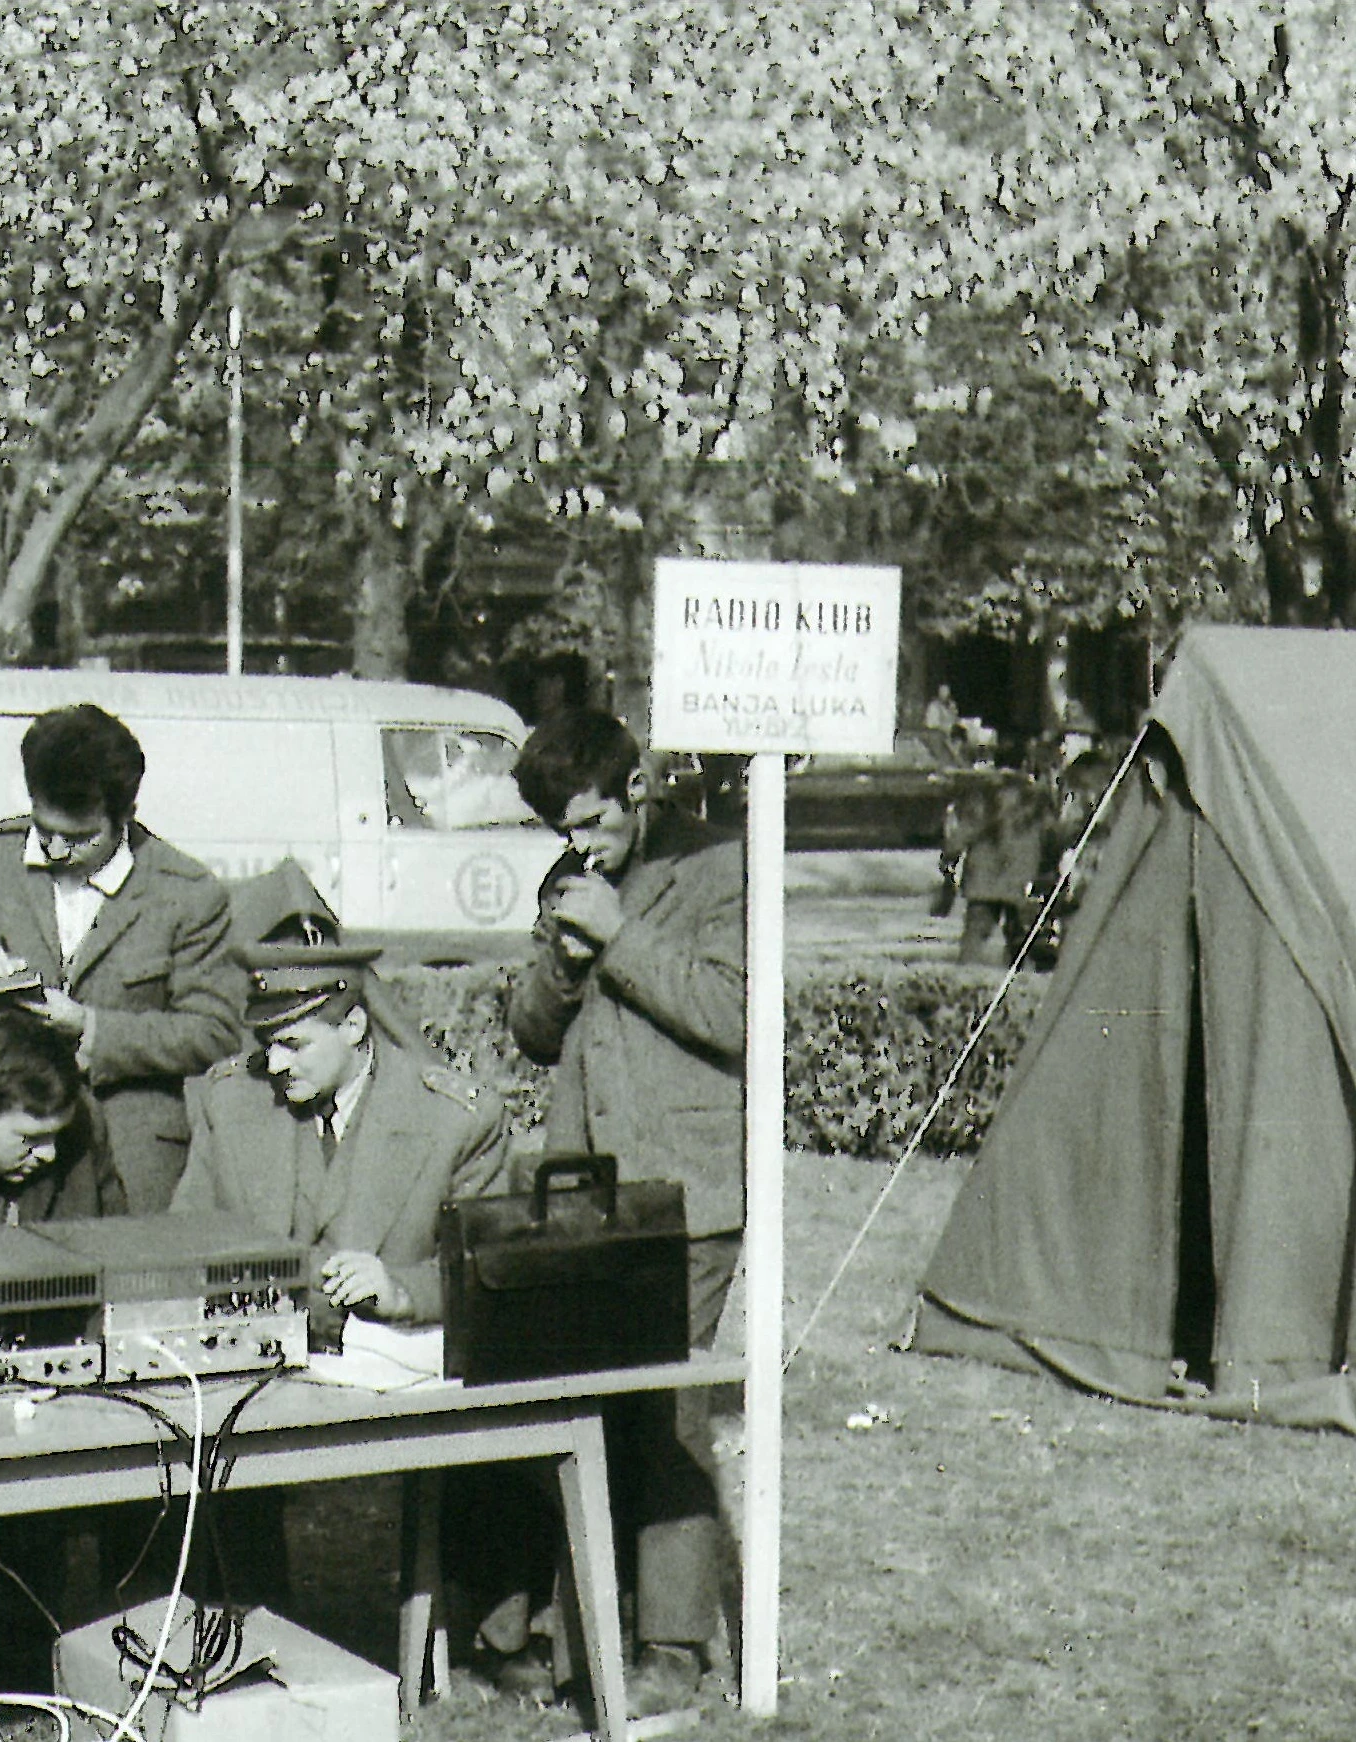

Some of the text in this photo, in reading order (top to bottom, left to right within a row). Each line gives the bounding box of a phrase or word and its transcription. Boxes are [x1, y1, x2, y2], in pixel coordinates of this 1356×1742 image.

[685, 597, 872, 634] RADIO KLUB
[684, 638, 860, 684] Nikola Tesla
[682, 691, 867, 717] BANJA LUKA
